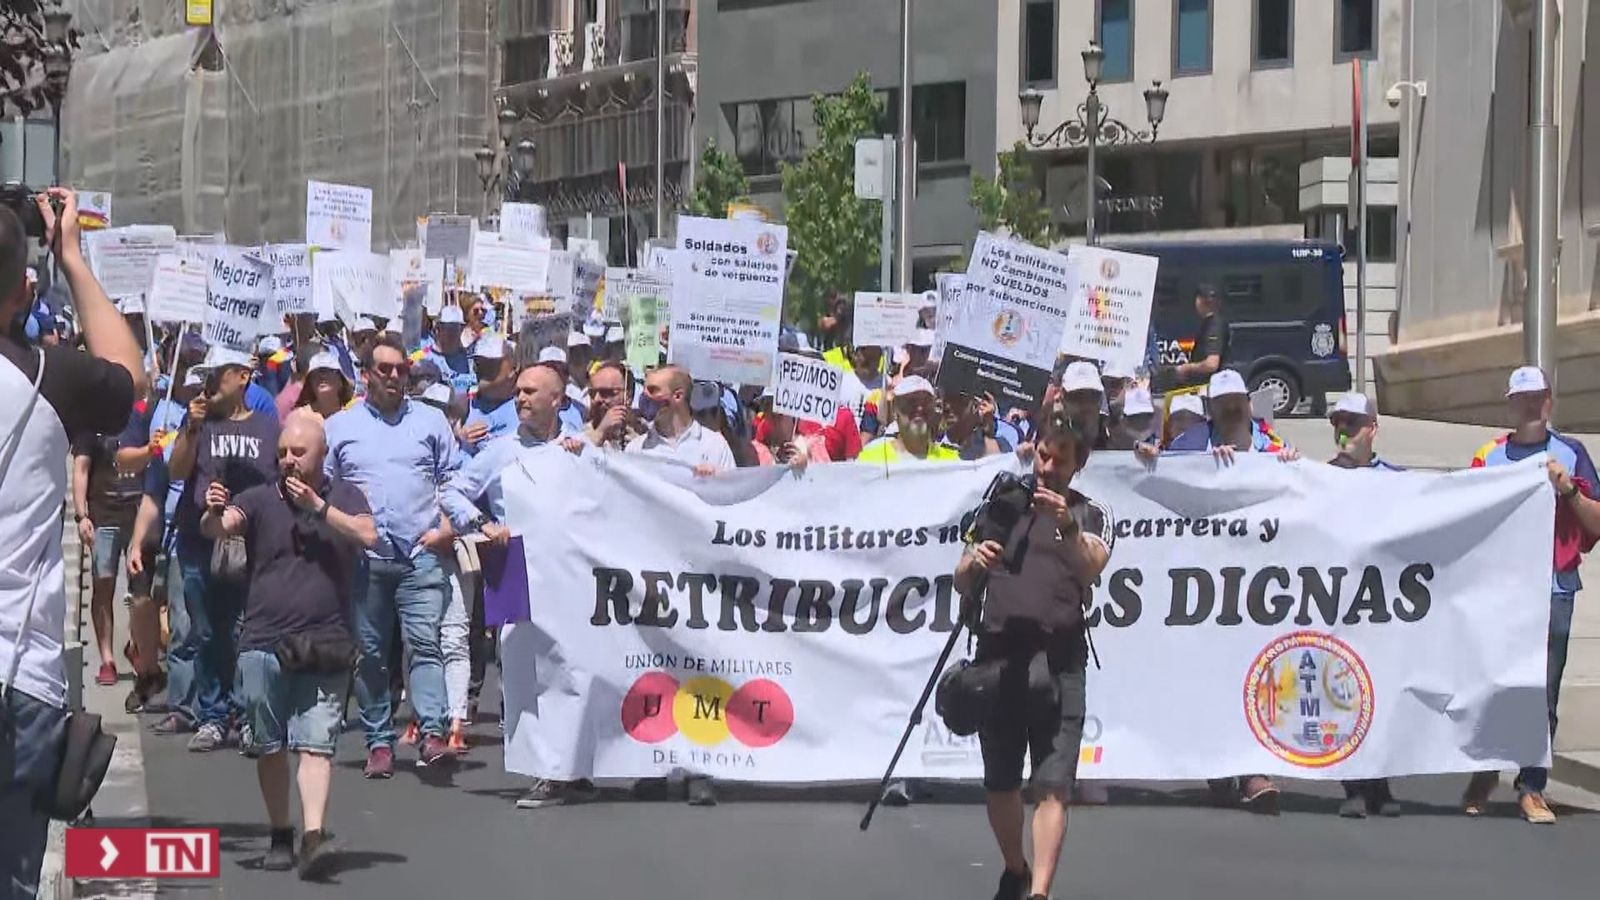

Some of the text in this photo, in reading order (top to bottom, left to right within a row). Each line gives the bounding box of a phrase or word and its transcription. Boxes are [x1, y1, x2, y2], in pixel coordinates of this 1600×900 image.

[685, 239, 747, 254] Soldados
[270, 253, 304, 269] Mejorar
[711, 258, 778, 271] con salarios
[991, 246, 1066, 275] Los militares
[213, 258, 262, 287] Mejorar
[705, 268, 718, 277] de
[981, 257, 1067, 291] NO cambiamos
[992, 274, 1049, 298] SUELDOS
[966, 282, 986, 293] por
[988, 288, 1067, 318] subvenciones
[707, 314, 737, 324] dinero
[701, 335, 746, 346] FAMILIAS
[731, 328, 773, 338] nuestras
[711, 520, 767, 548] Los
[775, 525, 928, 551] militares
[1115, 516, 1248, 538] carrera
[1259, 518, 1279, 543] y
[1164, 562, 1434, 626] DIGNAS
[683, 656, 706, 672] DE
[710, 659, 793, 676] MILITARES
[653, 749, 679, 765] DE
